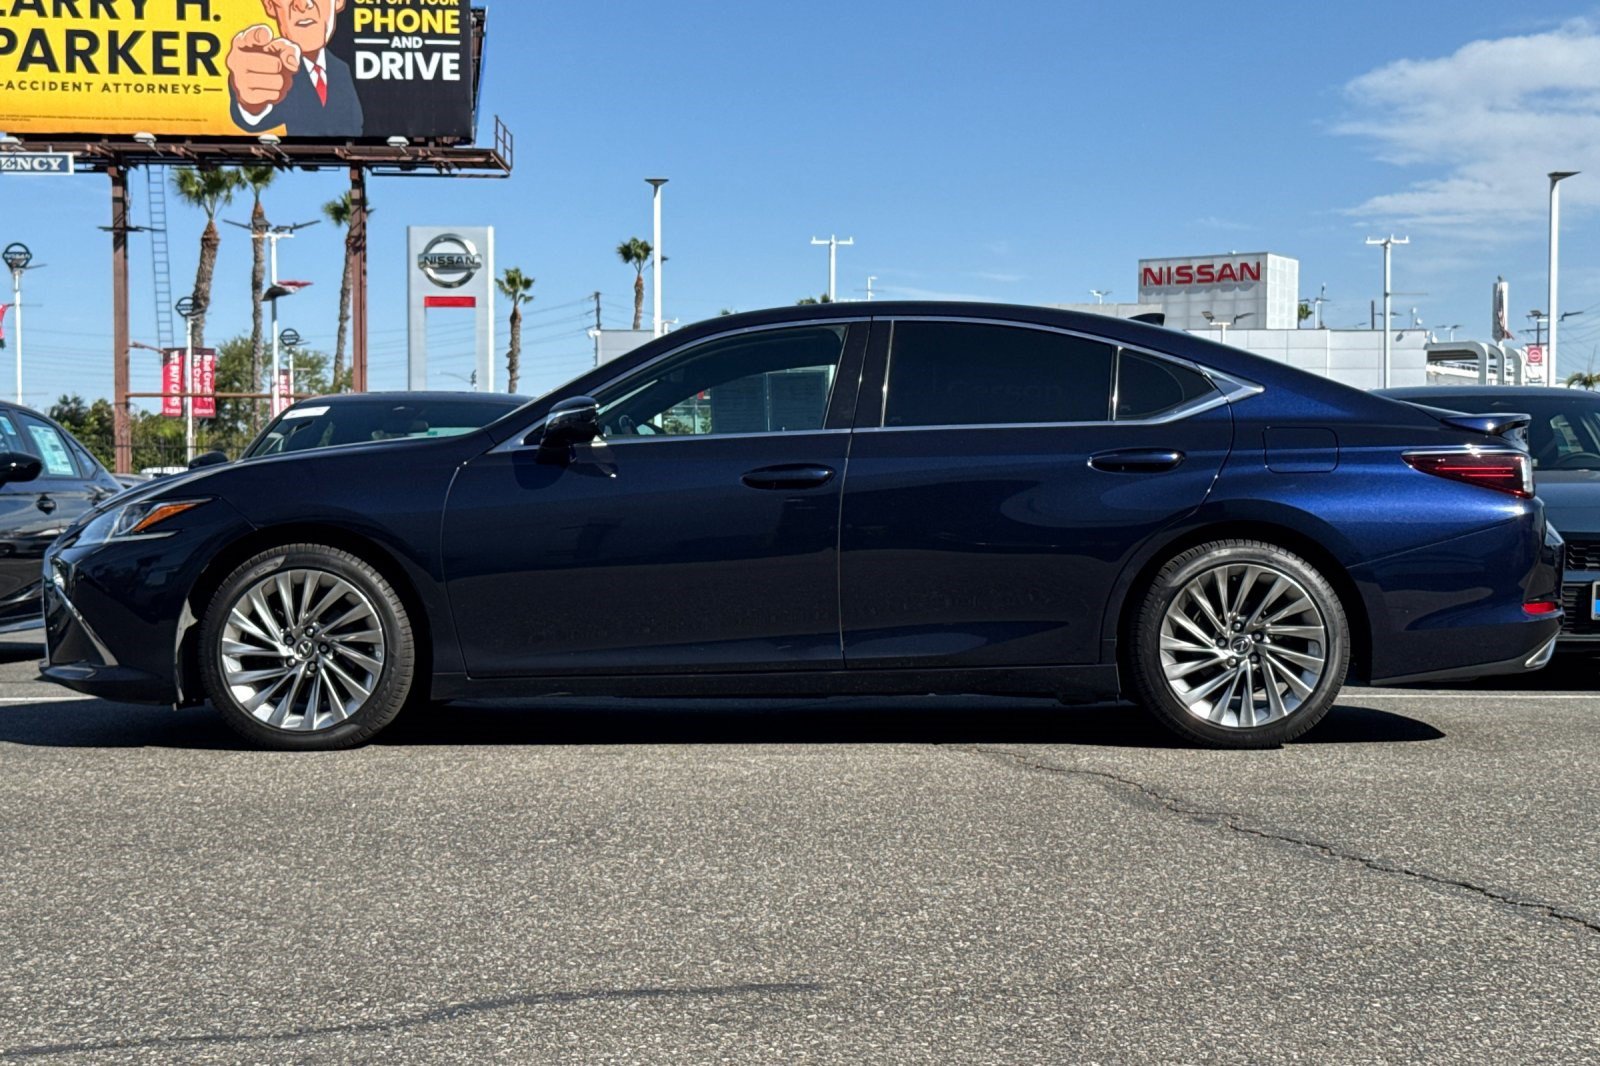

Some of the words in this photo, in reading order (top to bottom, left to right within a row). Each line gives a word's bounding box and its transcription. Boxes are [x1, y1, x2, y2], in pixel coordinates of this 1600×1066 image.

[354, 7, 460, 34] PHONE
[391, 36, 423, 49] AND
[355, 51, 460, 81] DRIVE
[5, 80, 93, 93] ACCIDENT
[101, 83, 202, 94] ATTORNEYS
[424, 256, 475, 265] NISSAN
[1143, 261, 1261, 286] NISSAN
